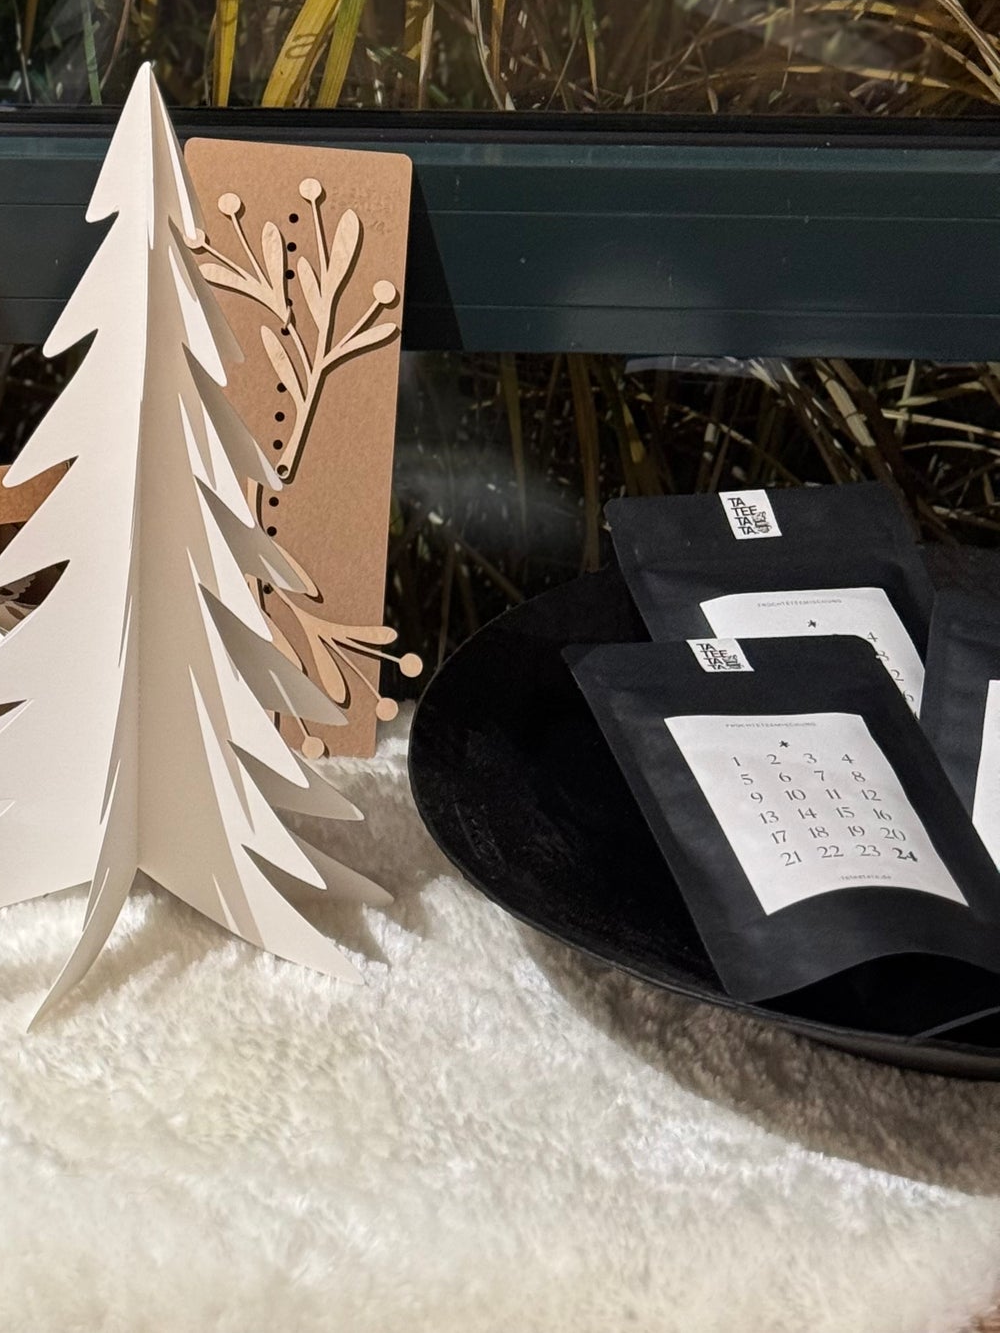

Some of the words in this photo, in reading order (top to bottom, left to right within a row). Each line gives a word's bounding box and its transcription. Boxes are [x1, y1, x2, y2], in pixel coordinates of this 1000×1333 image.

[728, 498, 745, 507] TA
[731, 505, 757, 516] TEE
[734, 517, 753, 526] TA
[867, 632, 878, 642] 4
[700, 650, 727, 658] TEE
[733, 756, 741, 766] 1
[767, 754, 781, 765] 2
[803, 753, 817, 764] 3
[841, 754, 854, 764] 4
[741, 774, 753, 785] 5
[779, 772, 791, 782] 6
[814, 770, 825, 781] 7
[851, 771, 866, 782] 8
[750, 792, 764, 804] 9
[785, 789, 806, 800] 10
[825, 789, 842, 800] 11
[861, 789, 882, 801] 12
[759, 811, 779, 824] 13
[798, 808, 817, 819] 14
[836, 807, 854, 818] 15
[873, 808, 892, 821] 16
[771, 830, 786, 844] 17
[808, 827, 829, 838] 18
[848, 826, 865, 837] 19
[879, 827, 906, 841] 20
[781, 851, 802, 866] 21
[817, 846, 844, 858] 22
[855, 845, 881, 857] 23
[892, 847, 918, 862] 24
